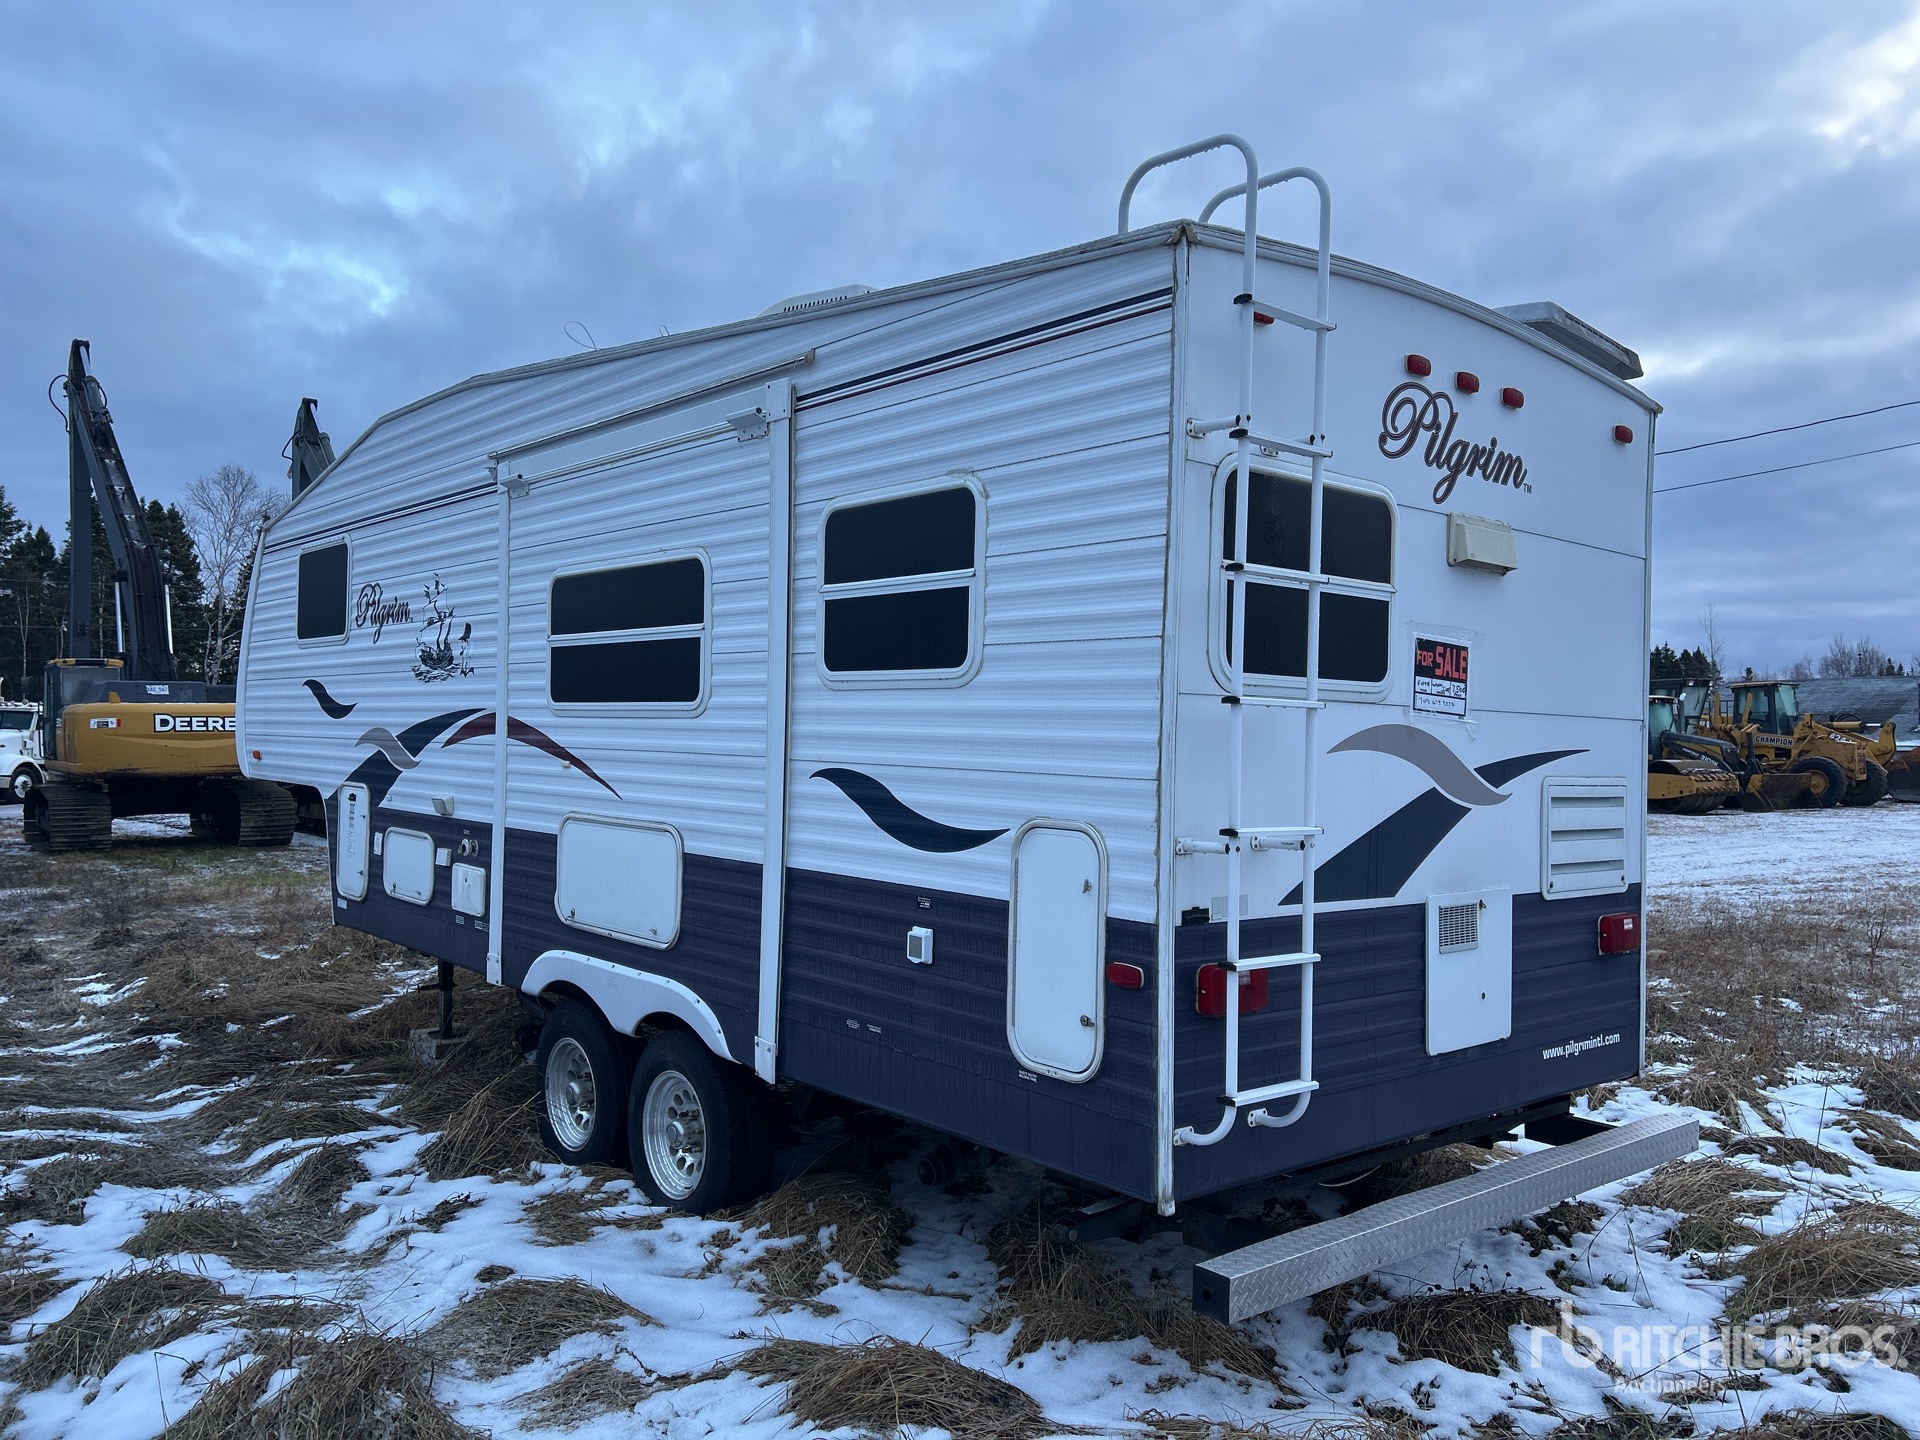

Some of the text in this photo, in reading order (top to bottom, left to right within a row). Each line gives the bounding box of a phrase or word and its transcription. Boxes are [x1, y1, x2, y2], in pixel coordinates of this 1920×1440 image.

[1378, 381, 1528, 505] Pilgrim
[355, 582, 411, 645] Pilgrim
[1416, 645, 1468, 680] FOR SALE
[154, 714, 236, 732] DEERE
[1755, 735, 1793, 746] CHAMPION
